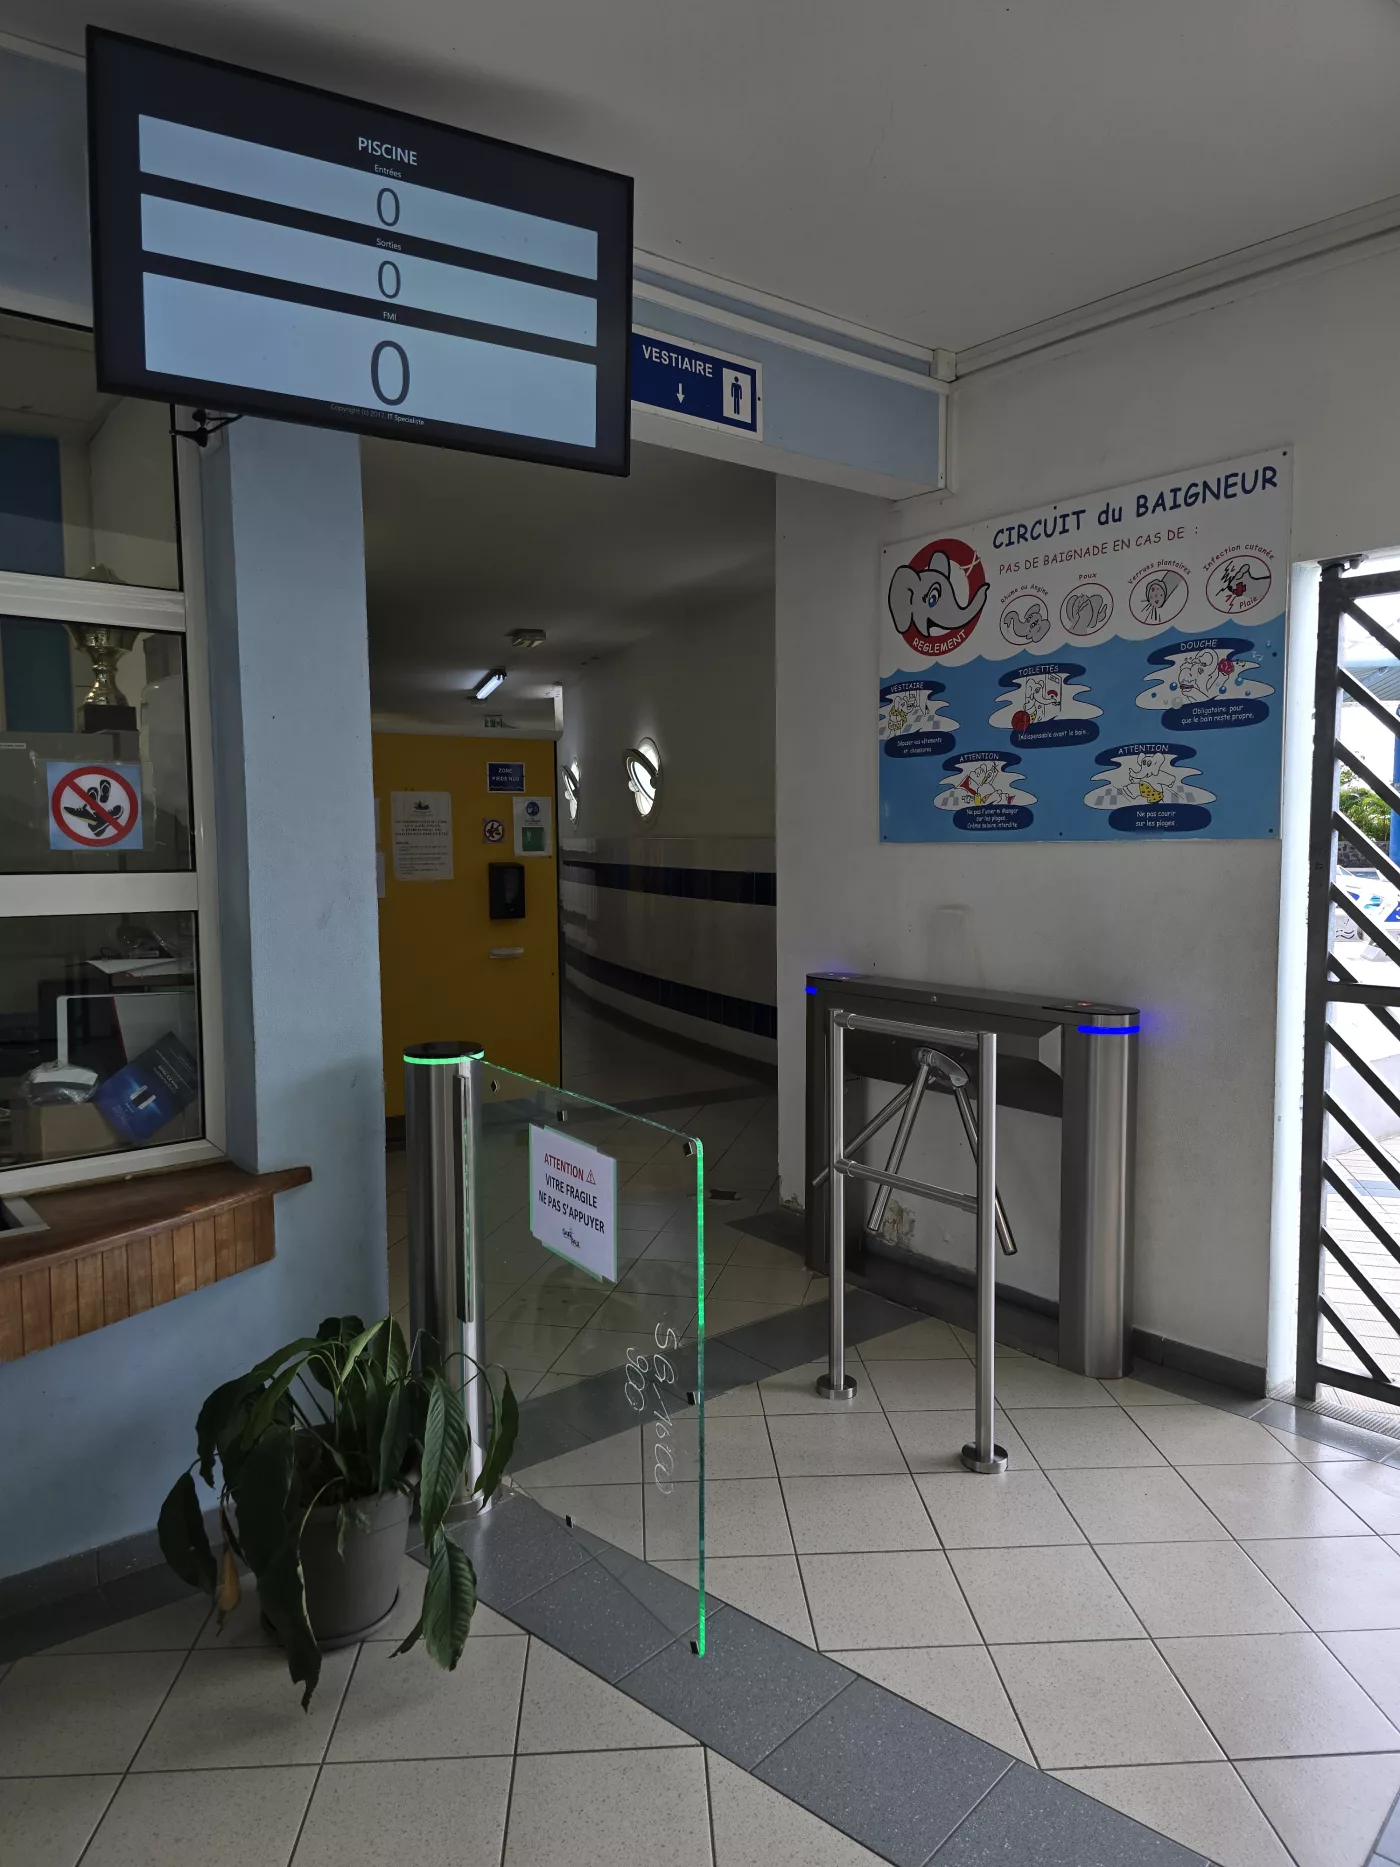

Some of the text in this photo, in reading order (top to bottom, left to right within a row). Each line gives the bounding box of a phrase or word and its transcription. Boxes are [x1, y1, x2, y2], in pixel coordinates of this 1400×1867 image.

[358, 137, 418, 166] PISCINE
[374, 164, 402, 178] Entrées
[377, 187, 400, 227] 0
[376, 238, 402, 251] Sorties
[377, 260, 401, 298] 0
[383, 311, 397, 321] FMI
[642, 344, 713, 378] VESTIAIRE
[371, 340, 410, 406] 0
[330, 403, 361, 415] Copyright
[993, 466, 1278, 549] CIRCUIT du BAIGNEUR
[999, 562, 1020, 575] PAS
[1024, 557, 1039, 570] DE
[1043, 542, 1108, 566] BAIGNADE
[1113, 538, 1131, 552] EN
[1135, 532, 1162, 547] CAS
[1167, 527, 1185, 541] DE
[1203, 544, 1275, 572] Infection cutanée
[1157, 559, 1192, 576] plantaires
[1239, 596, 1258, 609] Plaie
[912, 629, 968, 653] REGLEMENT
[1180, 639, 1218, 651] DOUCHE
[1018, 664, 1059, 677] TOILETTES
[890, 681, 925, 693] VESTIAIRE
[1229, 705, 1244, 713] pour
[959, 752, 999, 762] ATTENTION
[1118, 744, 1169, 755] ATTENTION
[544, 1153, 584, 1182] ATTENTION
[545, 1173, 598, 1209] VITRE FRAGILE
[538, 1189, 605, 1235] NE PAS S'APPUYER
